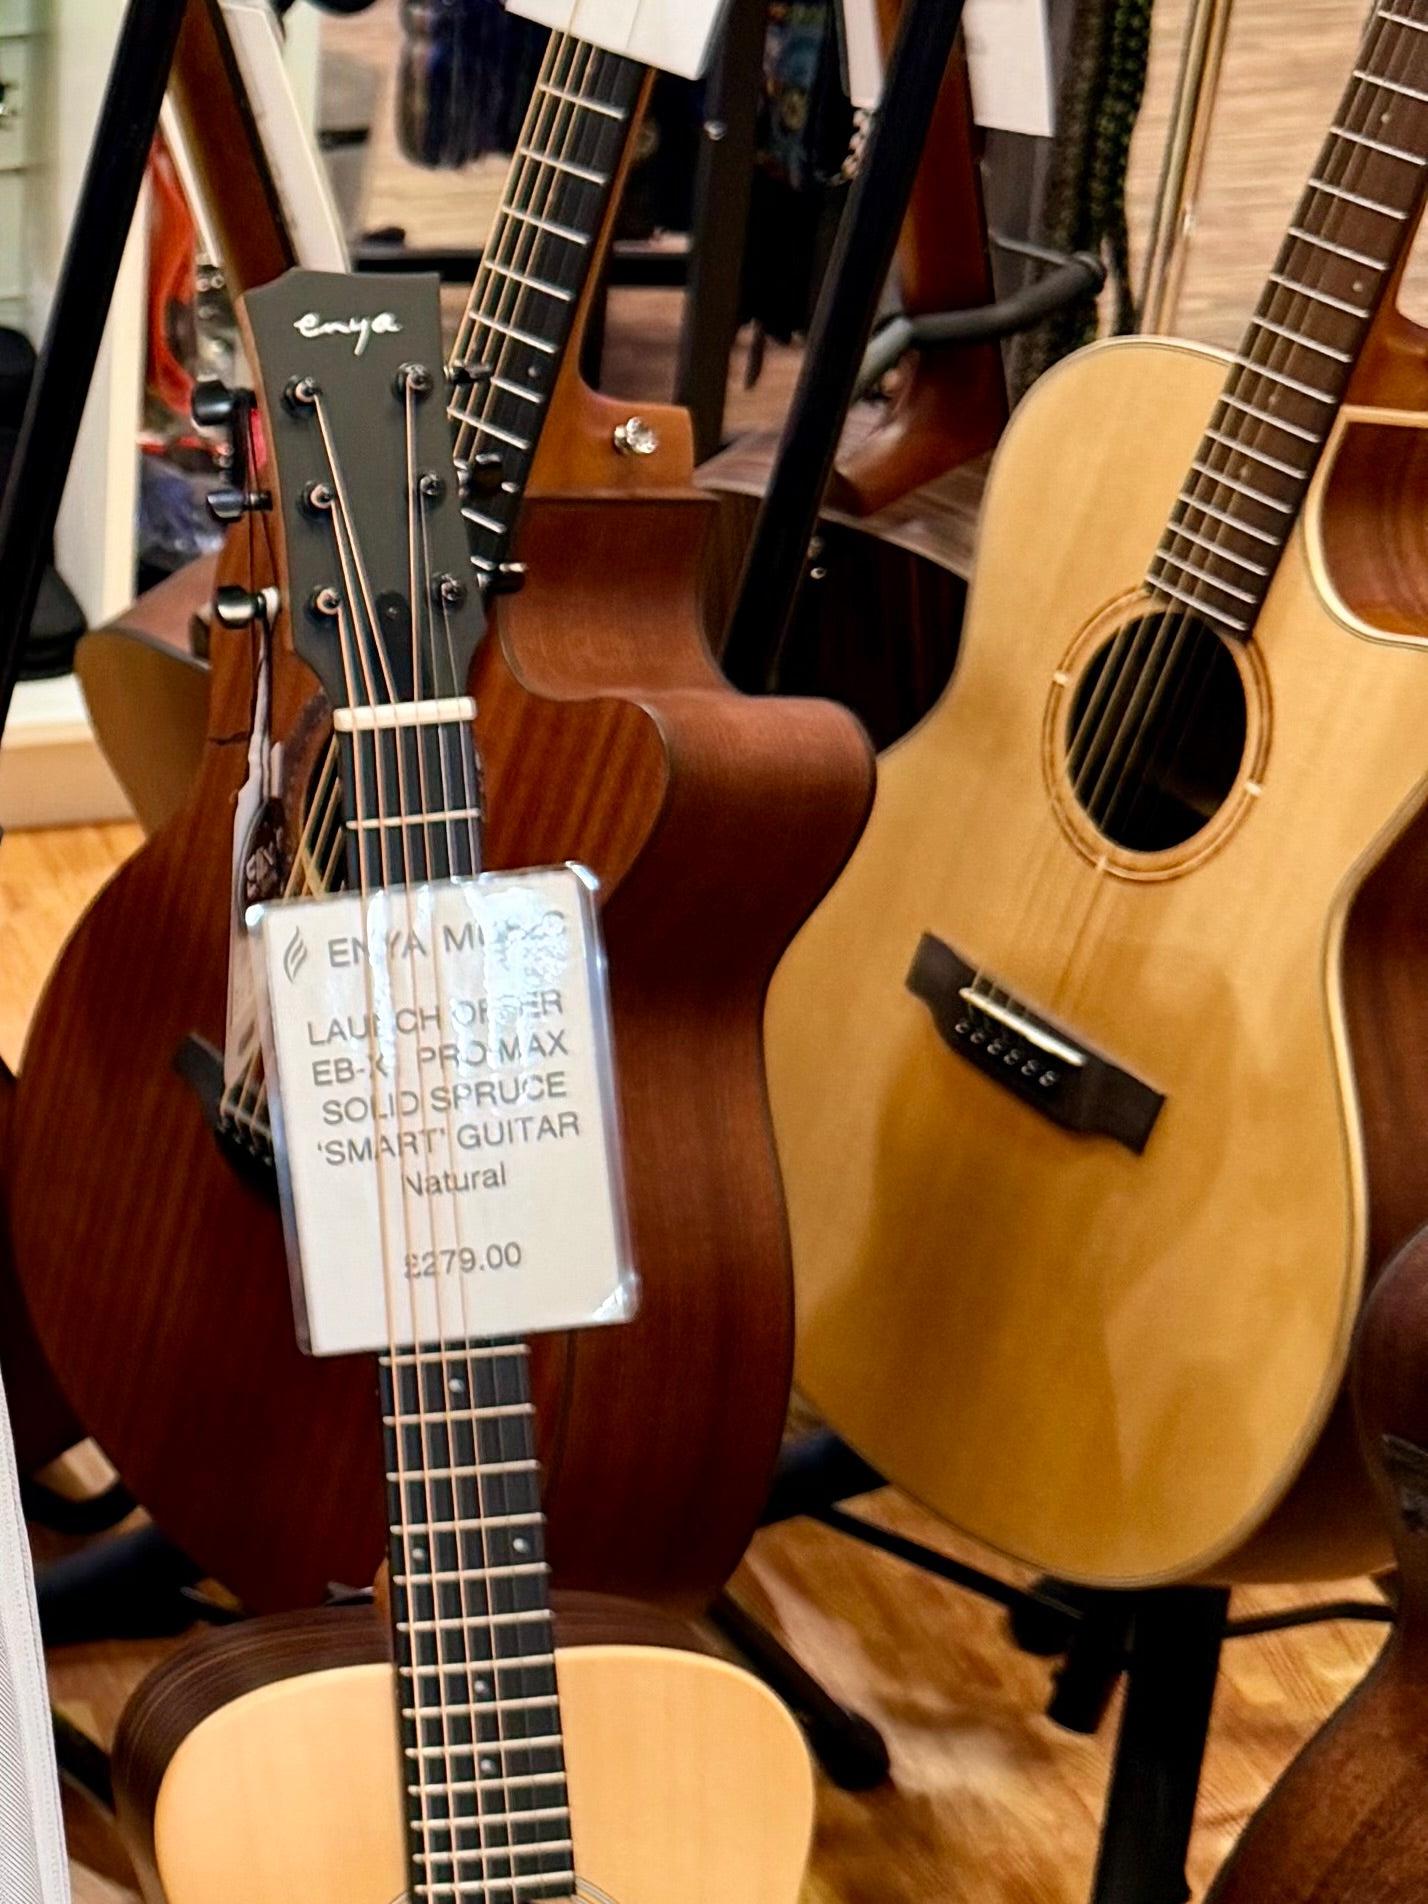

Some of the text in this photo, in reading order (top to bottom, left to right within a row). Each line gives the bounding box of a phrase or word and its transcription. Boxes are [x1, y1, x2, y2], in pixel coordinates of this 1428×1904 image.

[293, 312, 404, 357] enya
[496, 1029, 569, 1063] MAX
[321, 1070, 568, 1126] SOLID SPRUCE
[456, 1110, 581, 1150] GUITAR
[402, 1161, 507, 1197] Natural
[404, 1241, 523, 1281] £279.00
